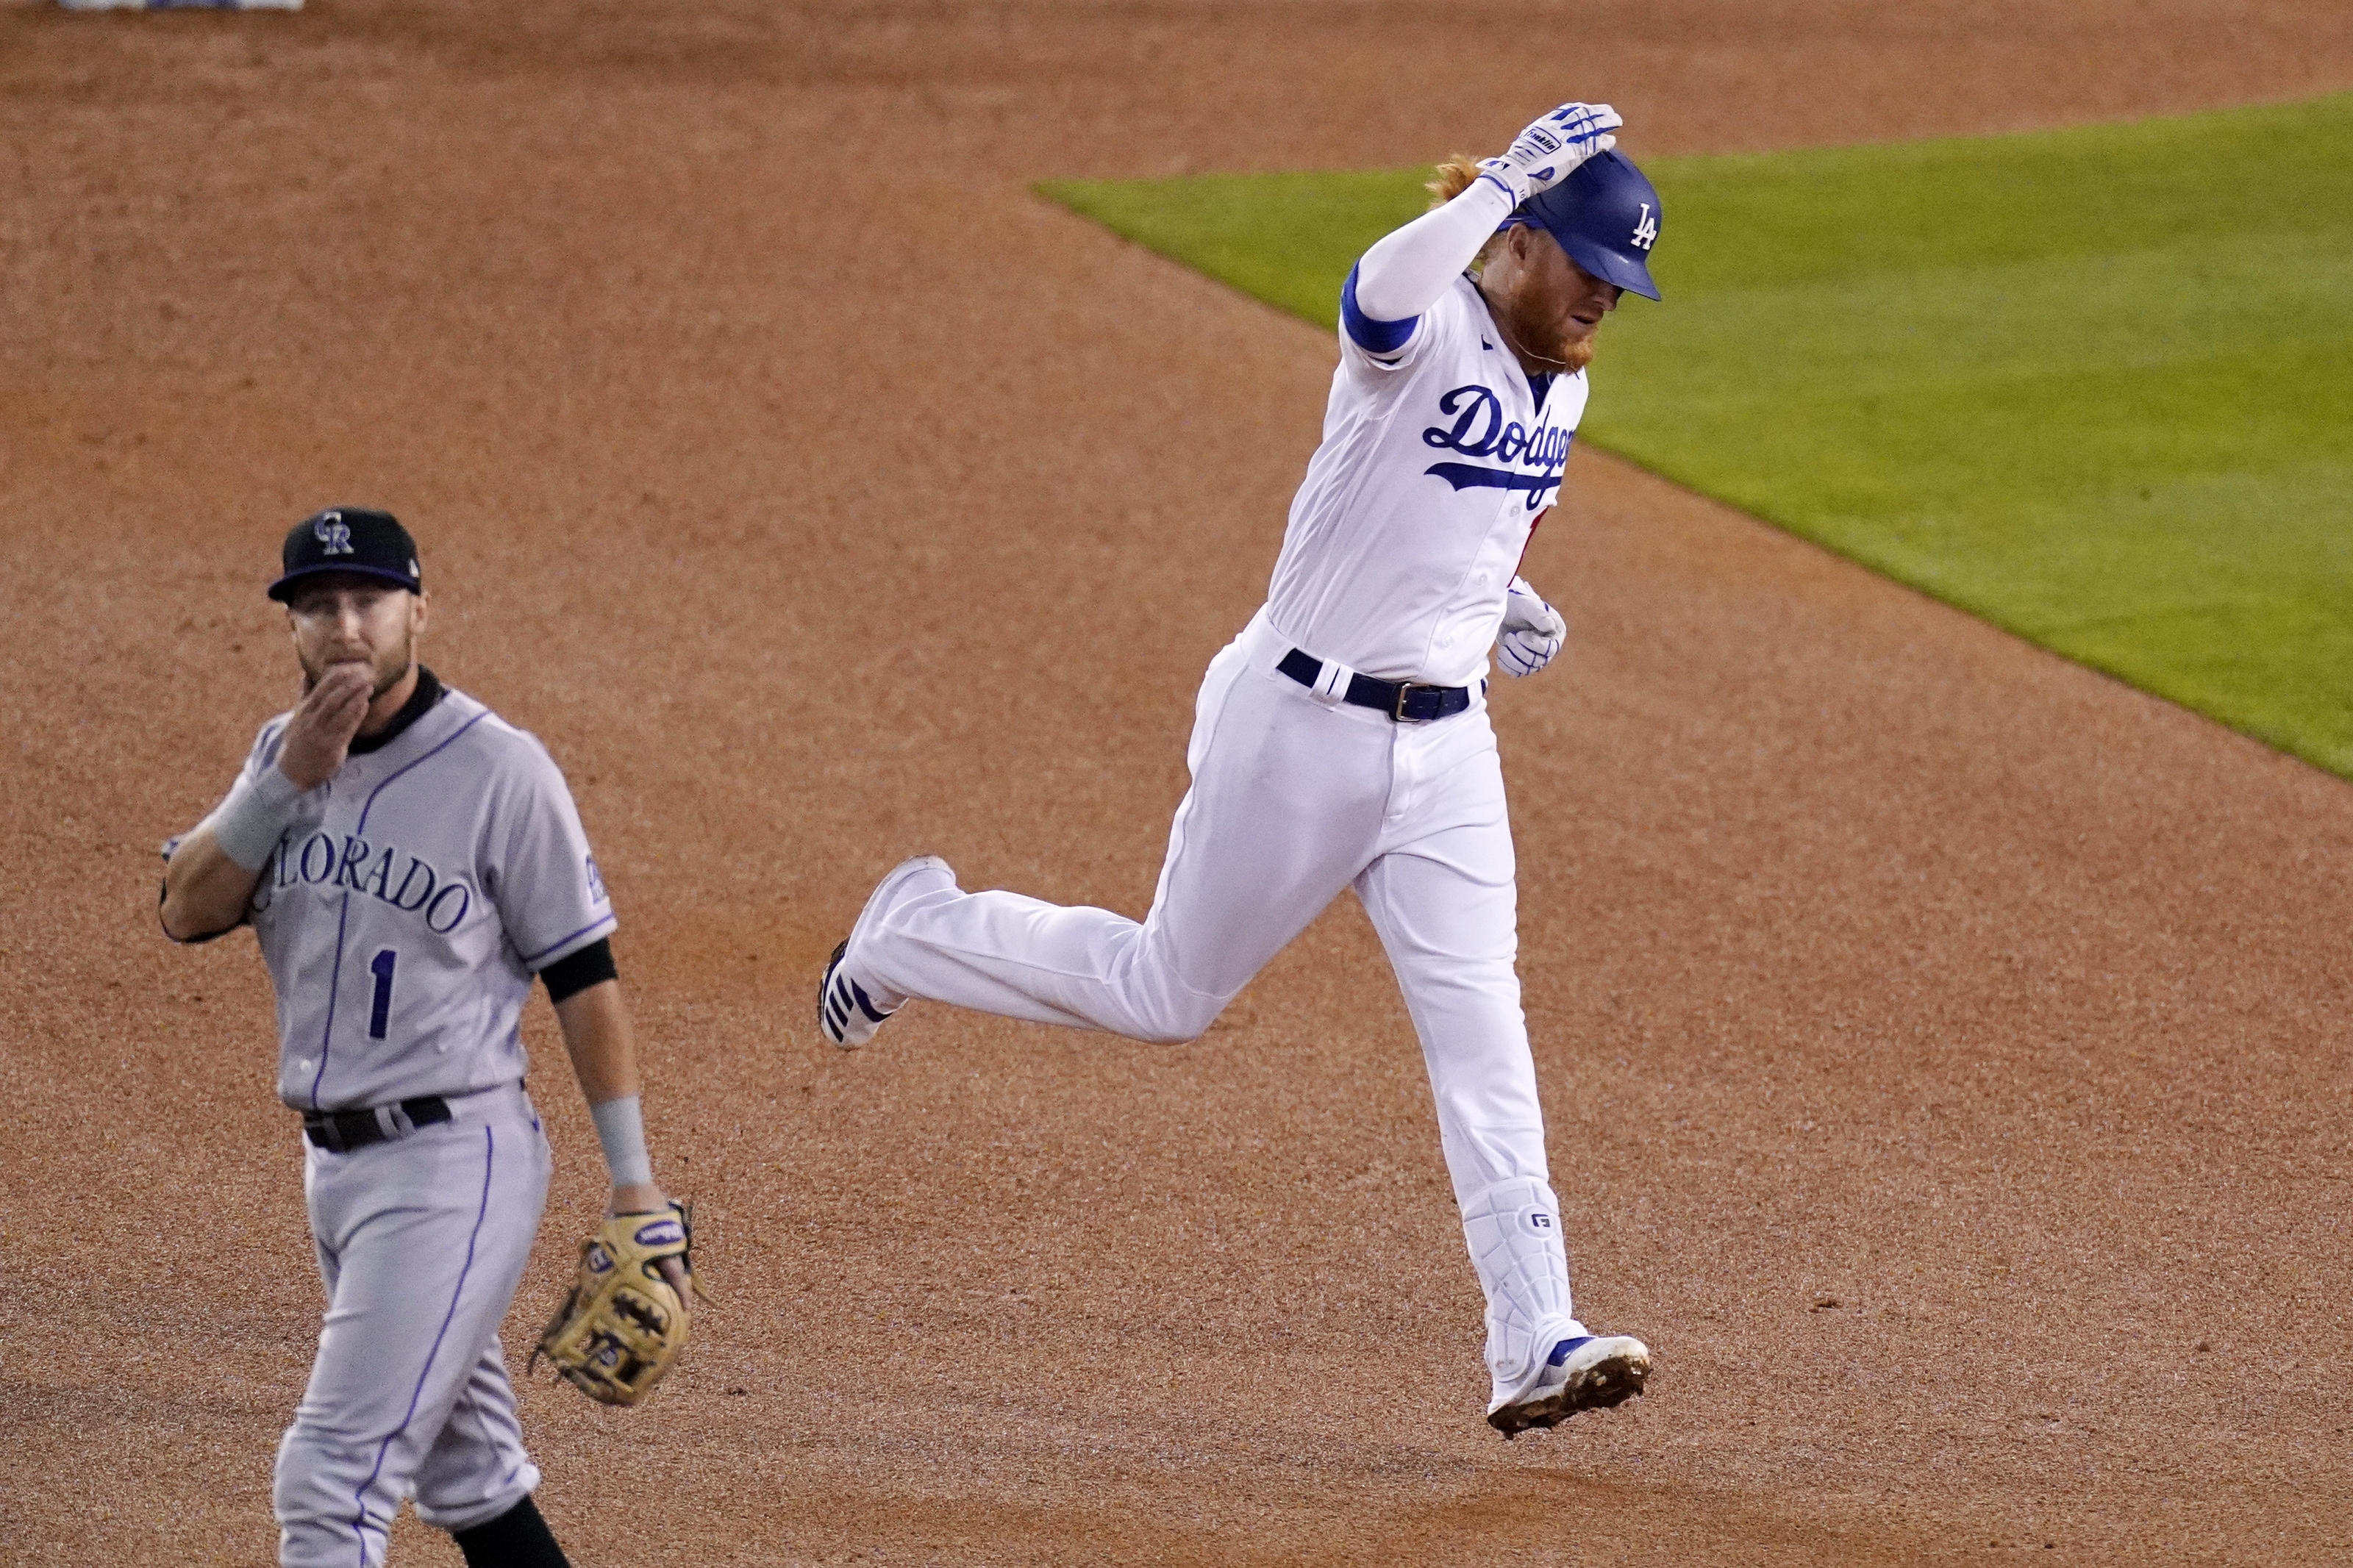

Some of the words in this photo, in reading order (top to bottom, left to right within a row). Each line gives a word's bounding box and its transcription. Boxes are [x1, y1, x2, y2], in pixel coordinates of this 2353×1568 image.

[1524, 128, 1556, 150] Franklin
[1630, 203, 1657, 250] LA
[254, 832, 471, 934] LORADO
[369, 949, 397, 1039] 1
